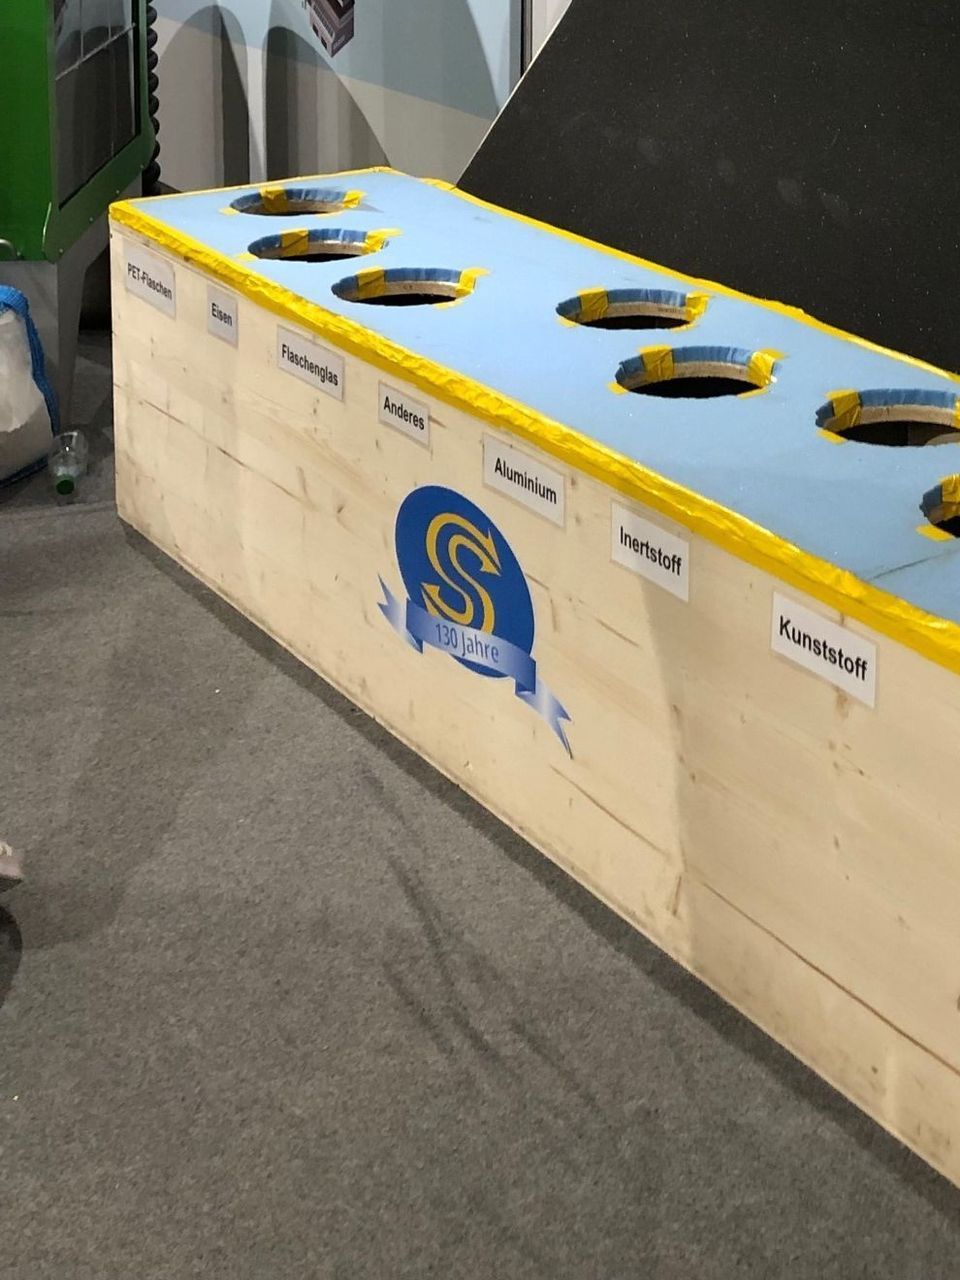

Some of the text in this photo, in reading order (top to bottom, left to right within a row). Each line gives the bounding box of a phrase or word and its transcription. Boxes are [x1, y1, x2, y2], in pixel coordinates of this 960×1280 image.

[127, 262, 173, 301] PET-Flaschen
[211, 302, 233, 327] Eisen
[281, 343, 339, 387] Flaschenglas
[383, 396, 425, 430] Anderes
[494, 457, 557, 505] Aluminium
[619, 525, 682, 576] Inertstoff
[435, 623, 500, 663] 130 Jahre
[779, 615, 868, 682] Kunststoff
